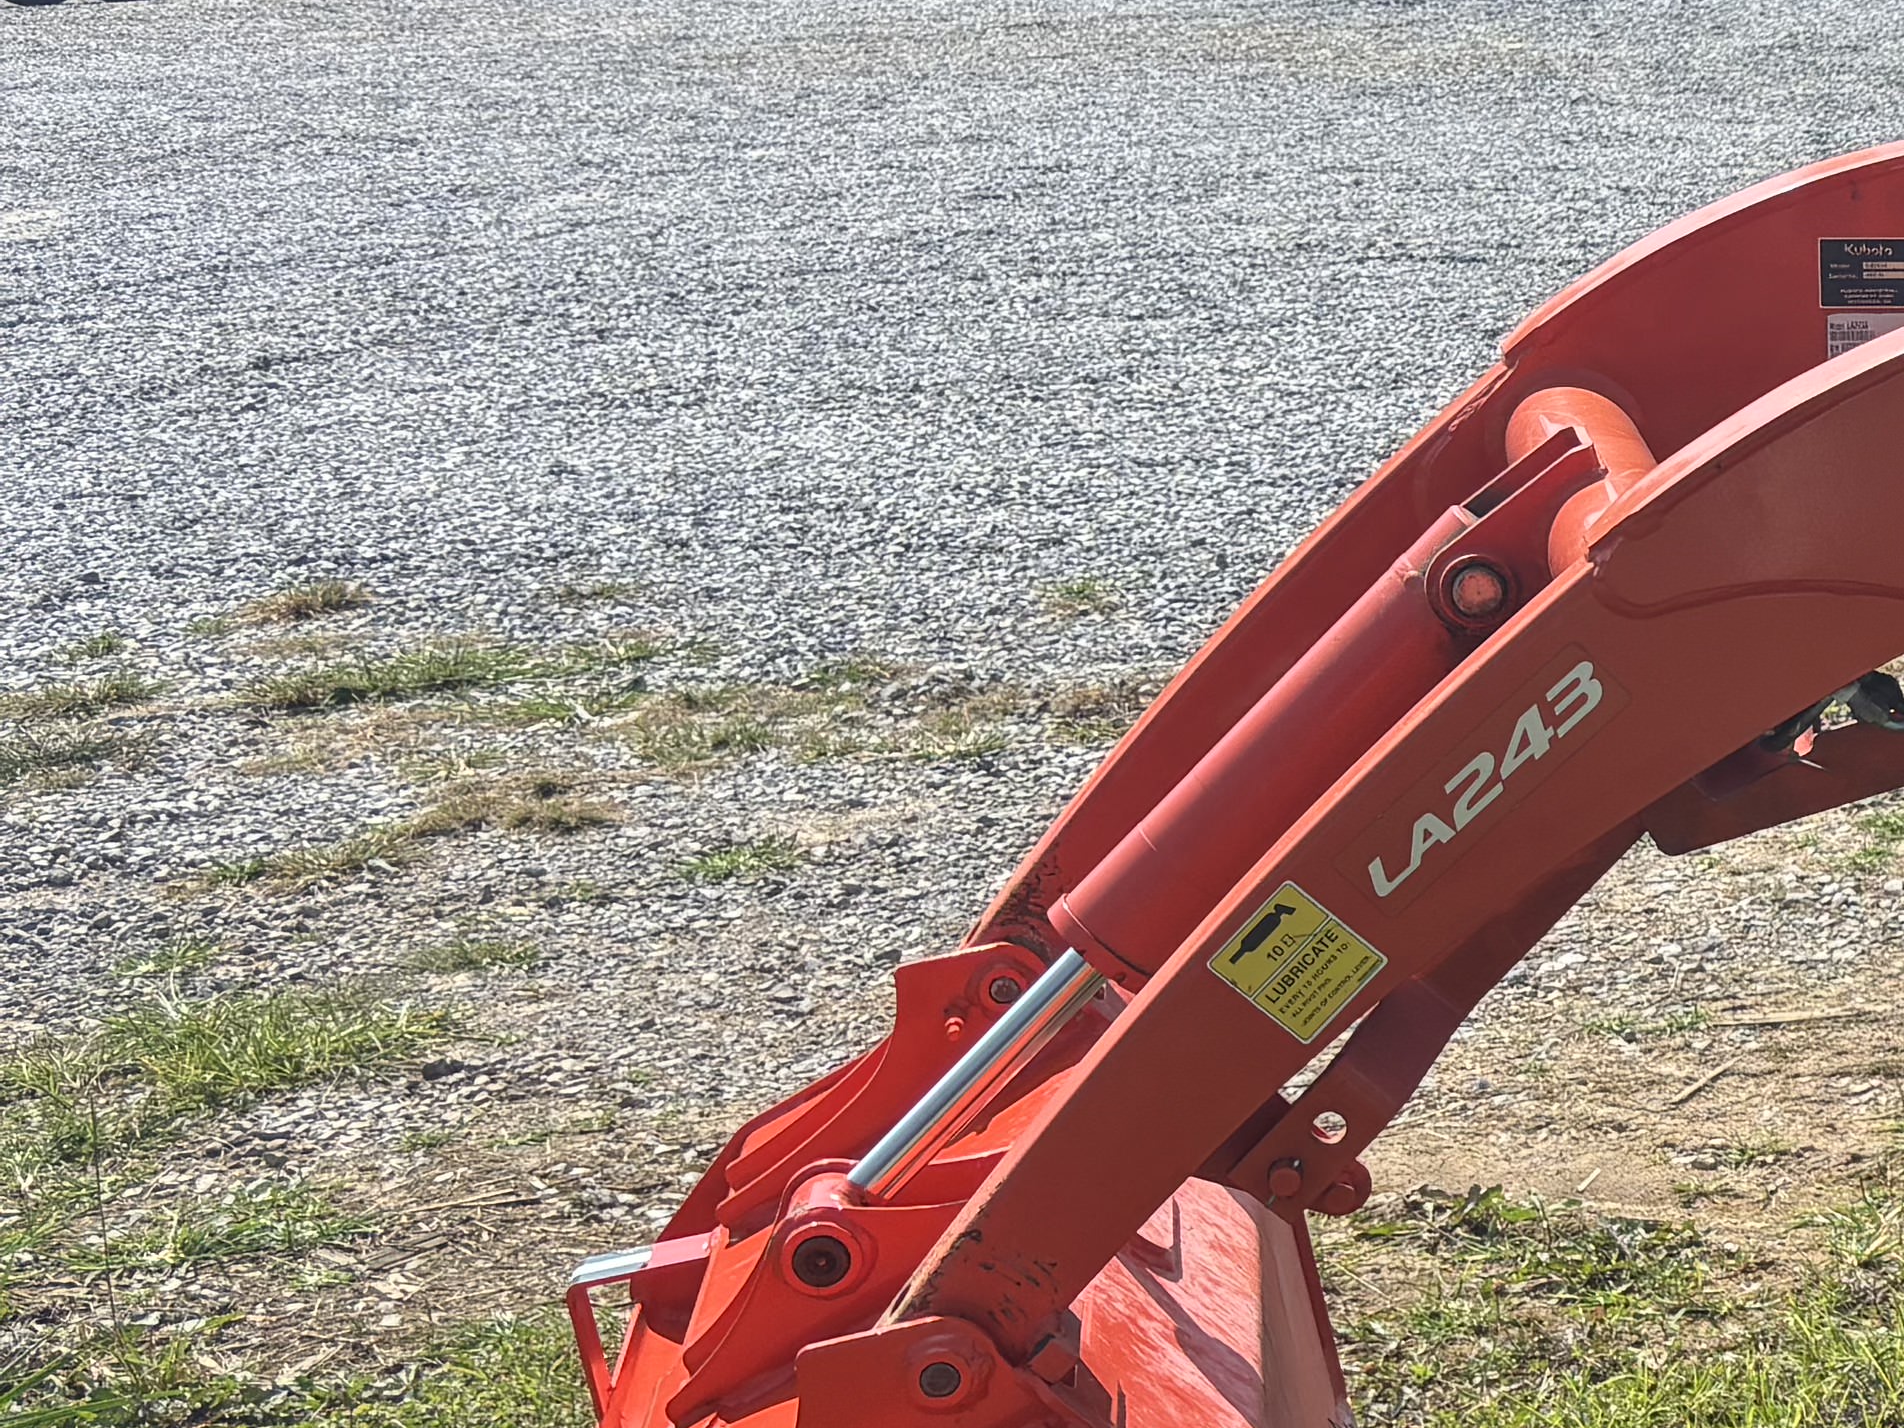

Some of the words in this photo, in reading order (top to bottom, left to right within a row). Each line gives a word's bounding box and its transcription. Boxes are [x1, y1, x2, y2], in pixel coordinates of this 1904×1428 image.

[1844, 244, 1893, 256] Kubota
[1367, 661, 1603, 897] LA243
[1265, 929, 1339, 1003] LUBRICATE
[1267, 945, 1284, 963] 10
